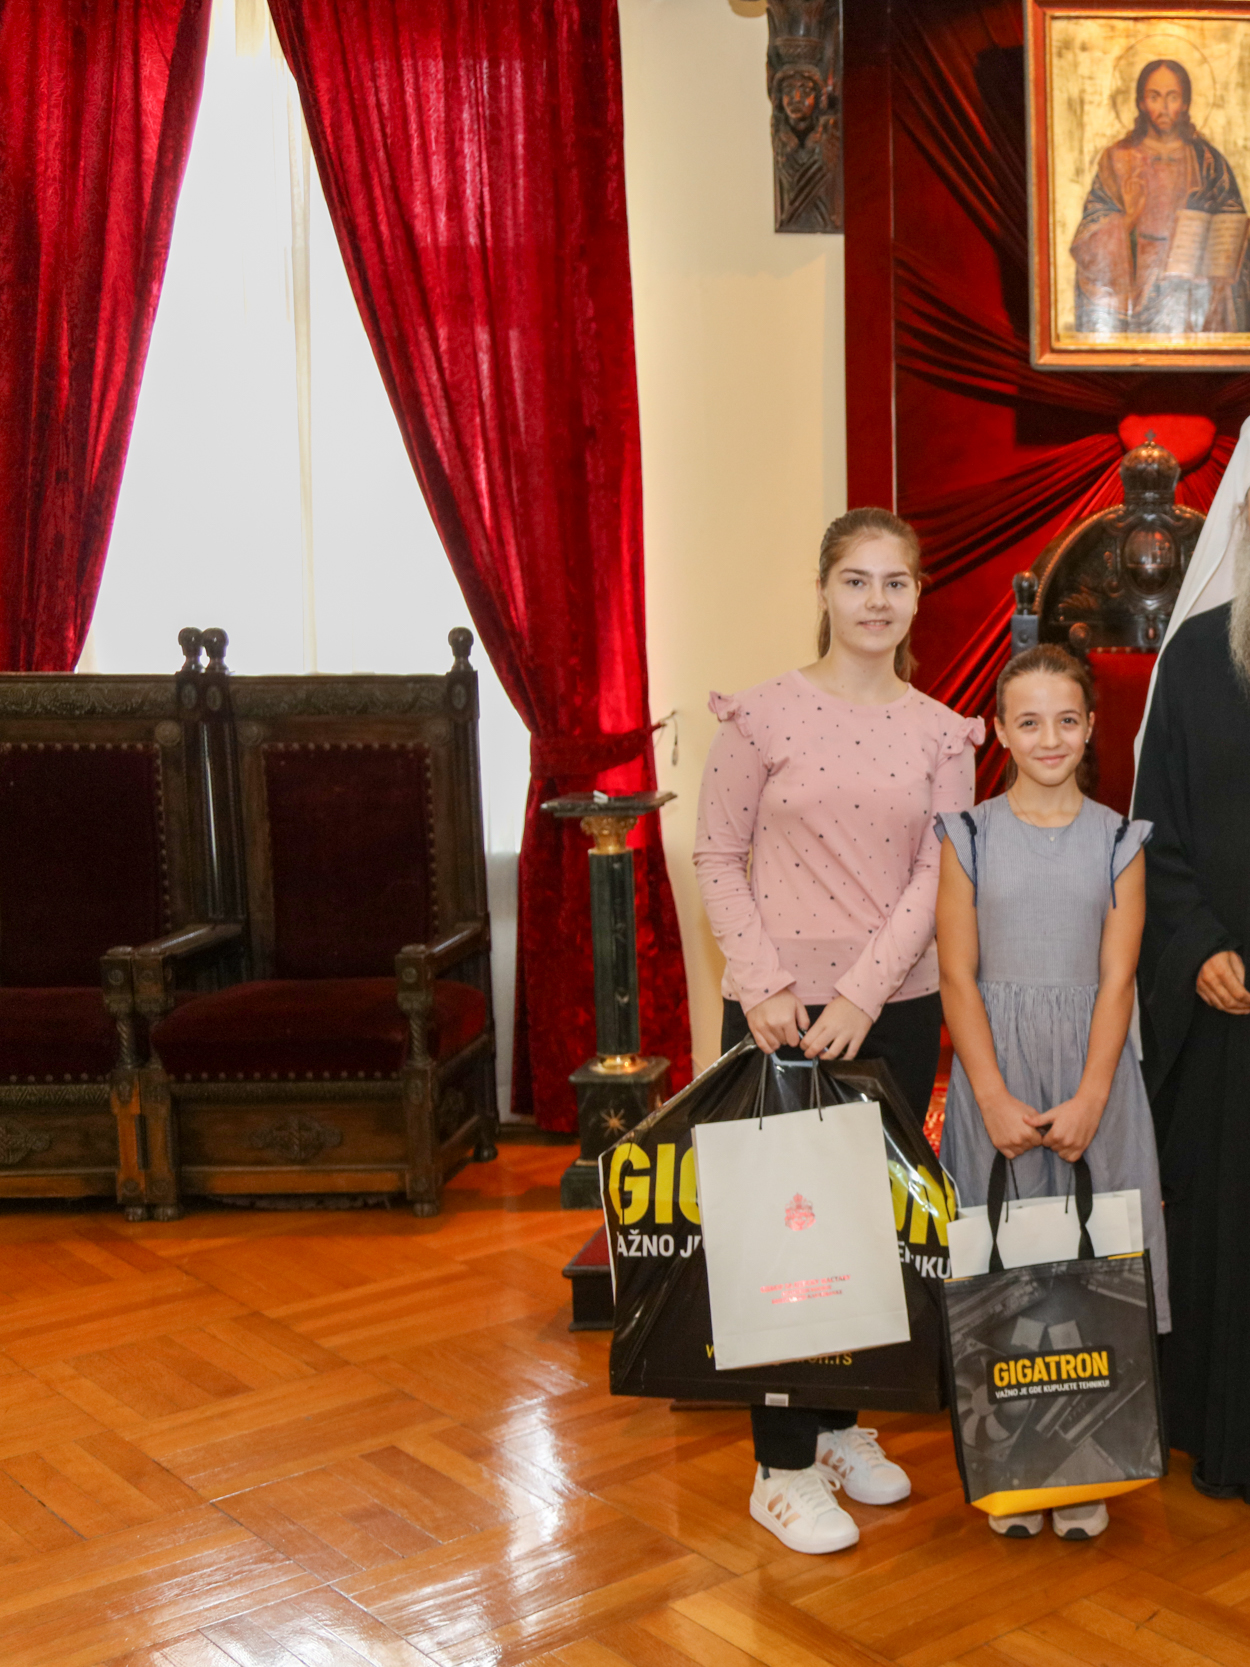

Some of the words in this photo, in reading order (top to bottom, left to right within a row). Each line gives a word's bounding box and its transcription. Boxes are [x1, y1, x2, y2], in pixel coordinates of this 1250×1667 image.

[993, 1350, 1109, 1388] GIGATRON
[995, 1387, 1019, 1400] VAŽNO
[1019, 1387, 1028, 1396] JE
[1028, 1384, 1041, 1395] GDE
[1043, 1381, 1078, 1393] KUPUJETE
